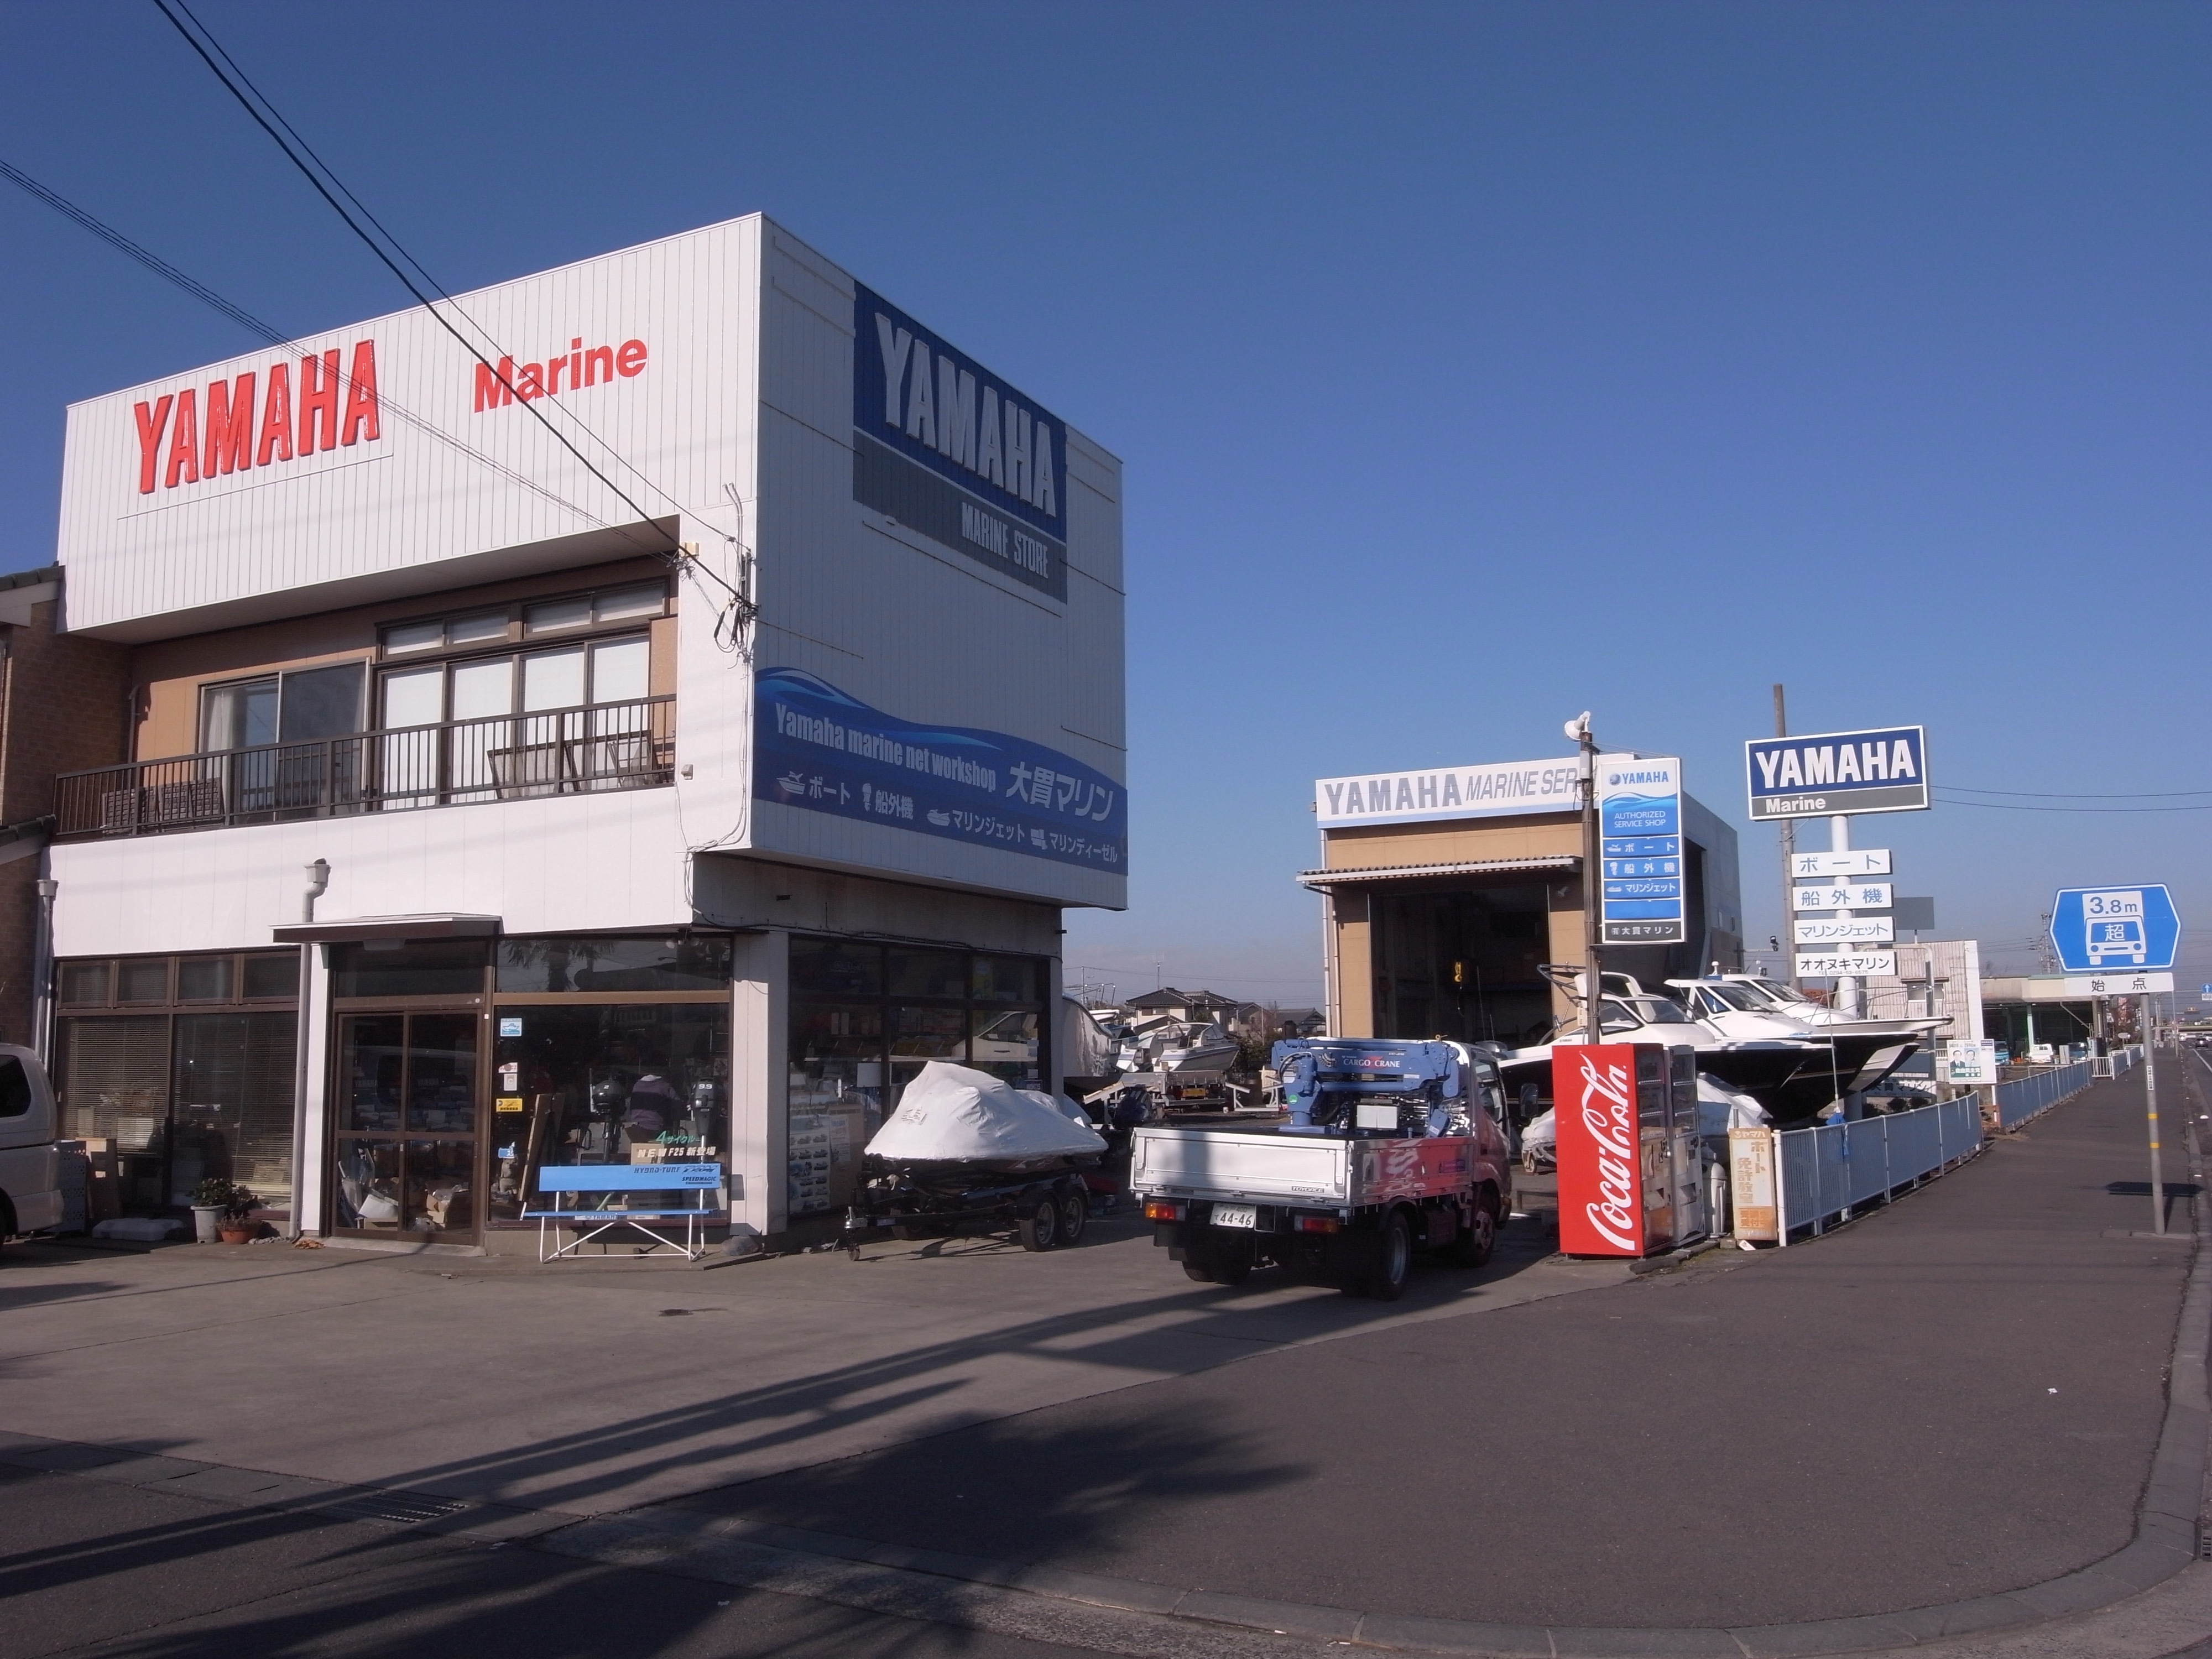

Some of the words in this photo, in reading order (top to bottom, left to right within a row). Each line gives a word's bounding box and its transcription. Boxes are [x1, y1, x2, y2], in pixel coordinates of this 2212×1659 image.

[133, 338, 382, 494] YAMAHA
[474, 337, 648, 414] Marine
[875, 312, 1056, 518] YAMAHA
[962, 502, 1009, 559] MARINE
[1014, 529, 1049, 579] STORE
[775, 702, 844, 751] Yamaha
[848, 728, 902, 766] marine
[906, 746, 930, 774] net
[931, 753, 997, 793] workshop
[1755, 739, 1916, 789] YAMAHA
[1622, 771, 1669, 785] YAMAHA
[1005, 761, 1114, 821] 大貫マリン
[1324, 773, 1462, 816] YAMAHA
[1465, 770, 1539, 802] MARINE
[1766, 796, 1826, 813] Marine
[808, 775, 851, 805] ボート
[875, 789, 914, 821] 船外機
[952, 810, 1025, 843] マリンジェット
[1050, 832, 1118, 863] マリンディーゼル
[1614, 811, 1666, 820] AUTHORIZED
[1614, 820, 1642, 828] SERVICE
[1645, 818, 1666, 827] SHOP
[1625, 883, 1676, 893] マリンジェット
[1798, 923, 1888, 938] マリンジェット
[2105, 923, 2125, 941] 超
[1801, 957, 1890, 971] オオヌキマリン
[1343, 1058, 1371, 1067] CARGO
[1374, 1060, 1400, 1068] CRANE
[638, 1147, 666, 1158] NEW
[668, 1147, 685, 1157] F25
[1579, 1050, 1635, 1251] Coca-Cola
[1751, 1141, 1767, 1173] ボート
[1220, 1212, 1253, 1225] 44-46
